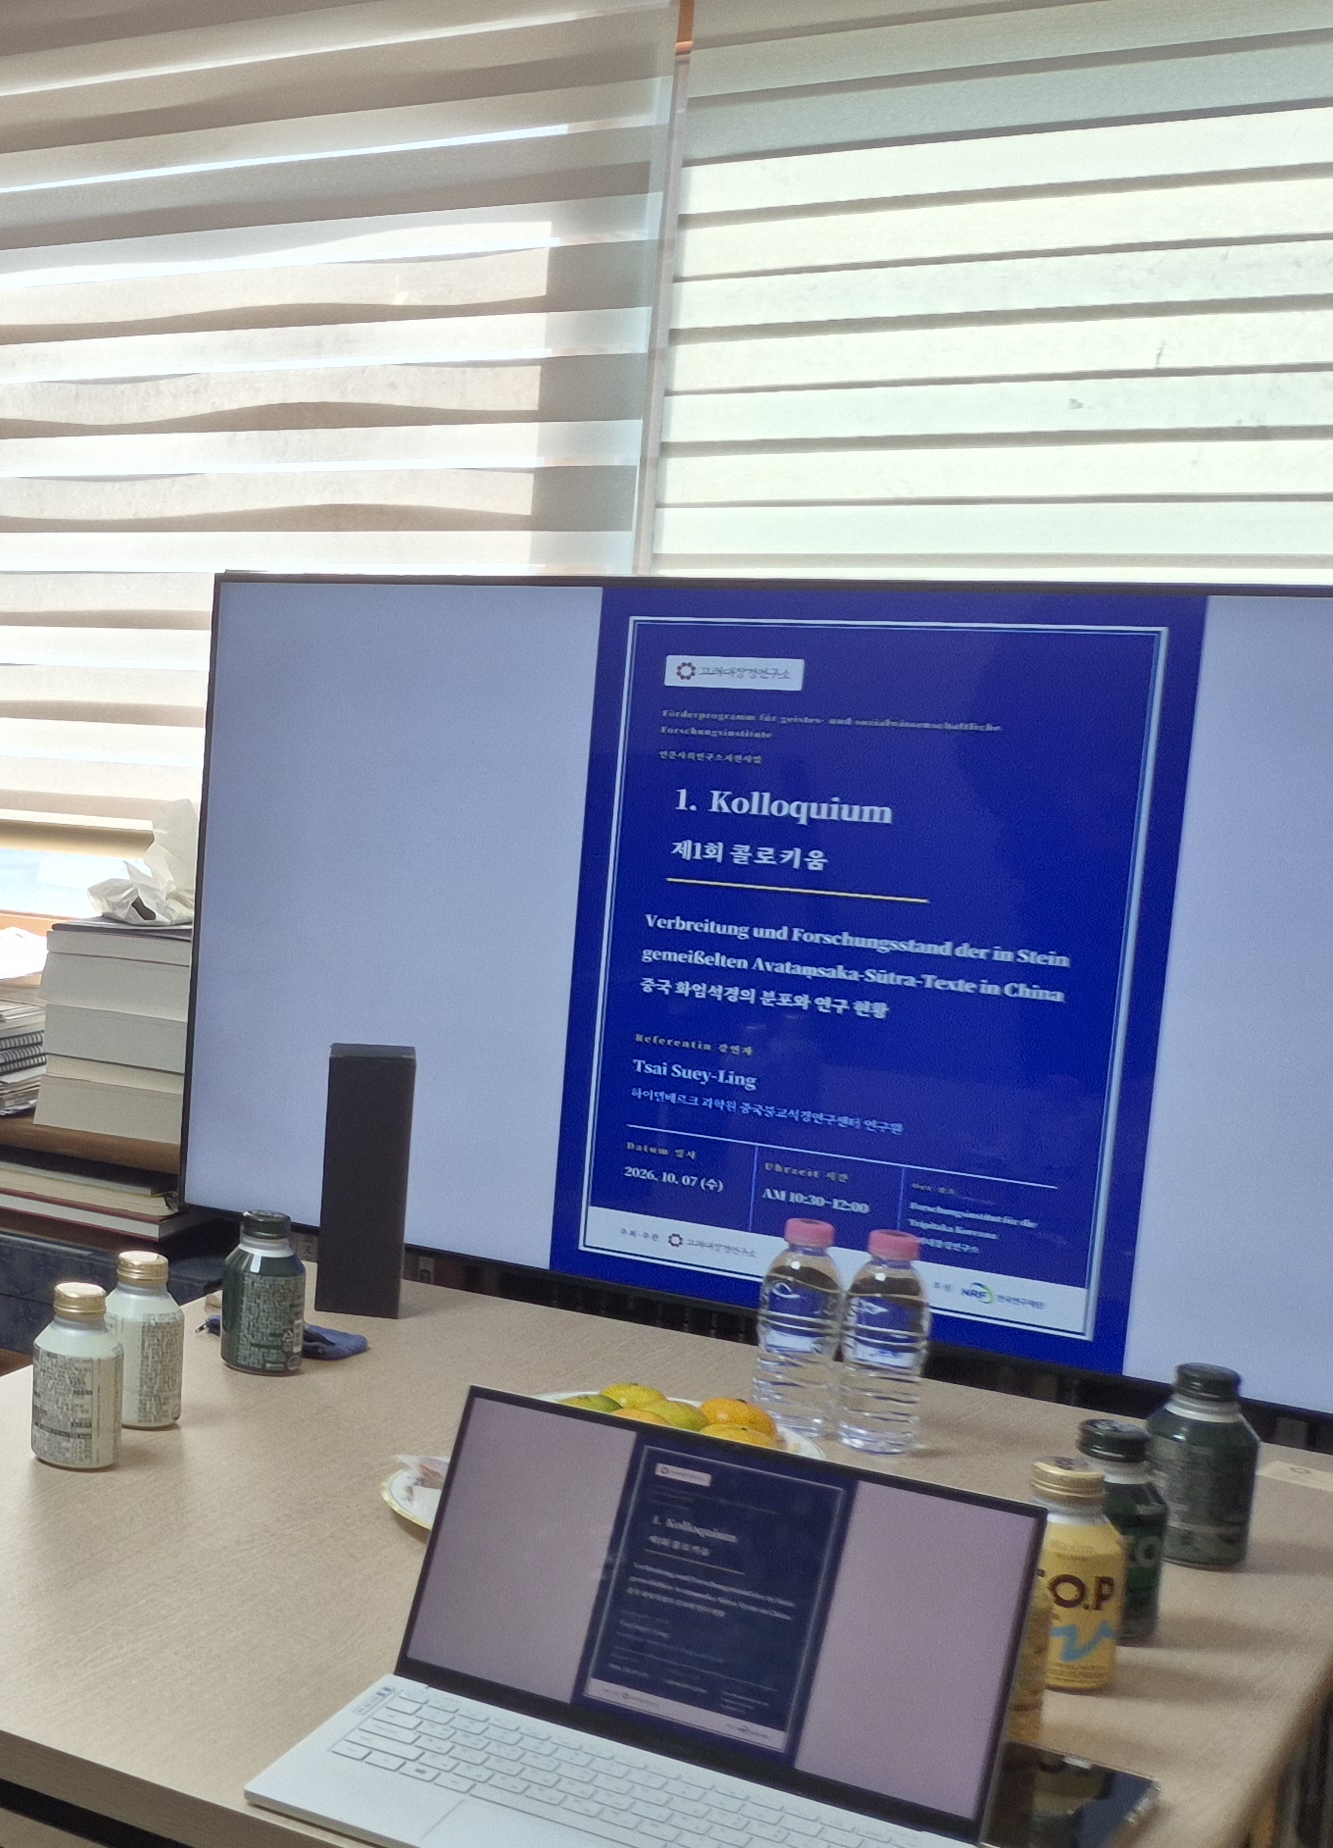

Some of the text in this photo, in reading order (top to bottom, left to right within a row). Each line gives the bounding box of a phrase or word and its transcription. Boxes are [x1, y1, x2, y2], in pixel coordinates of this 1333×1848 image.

[662, 709, 756, 722] Förderprogramm
[675, 788, 893, 825] 1. Kolloquium
[671, 839, 829, 871] 제1회 콜로키움
[644, 913, 1071, 967] Verbreitung und Forschungsstand der in Stein
[641, 948, 748, 970] gemeißelten
[979, 979, 1001, 996] in
[1004, 982, 1066, 1003] China
[640, 977, 890, 1019] 중국 화엄석경의 분포와 연구 현황
[633, 1058, 757, 1091] Tsai Suey-Ling
[624, 1165, 659, 1182] 2026.
[661, 1171, 679, 1186] 10.
[681, 1175, 698, 1188] 07
[762, 1187, 786, 1202] AM
[961, 1287, 987, 1300] NRF
